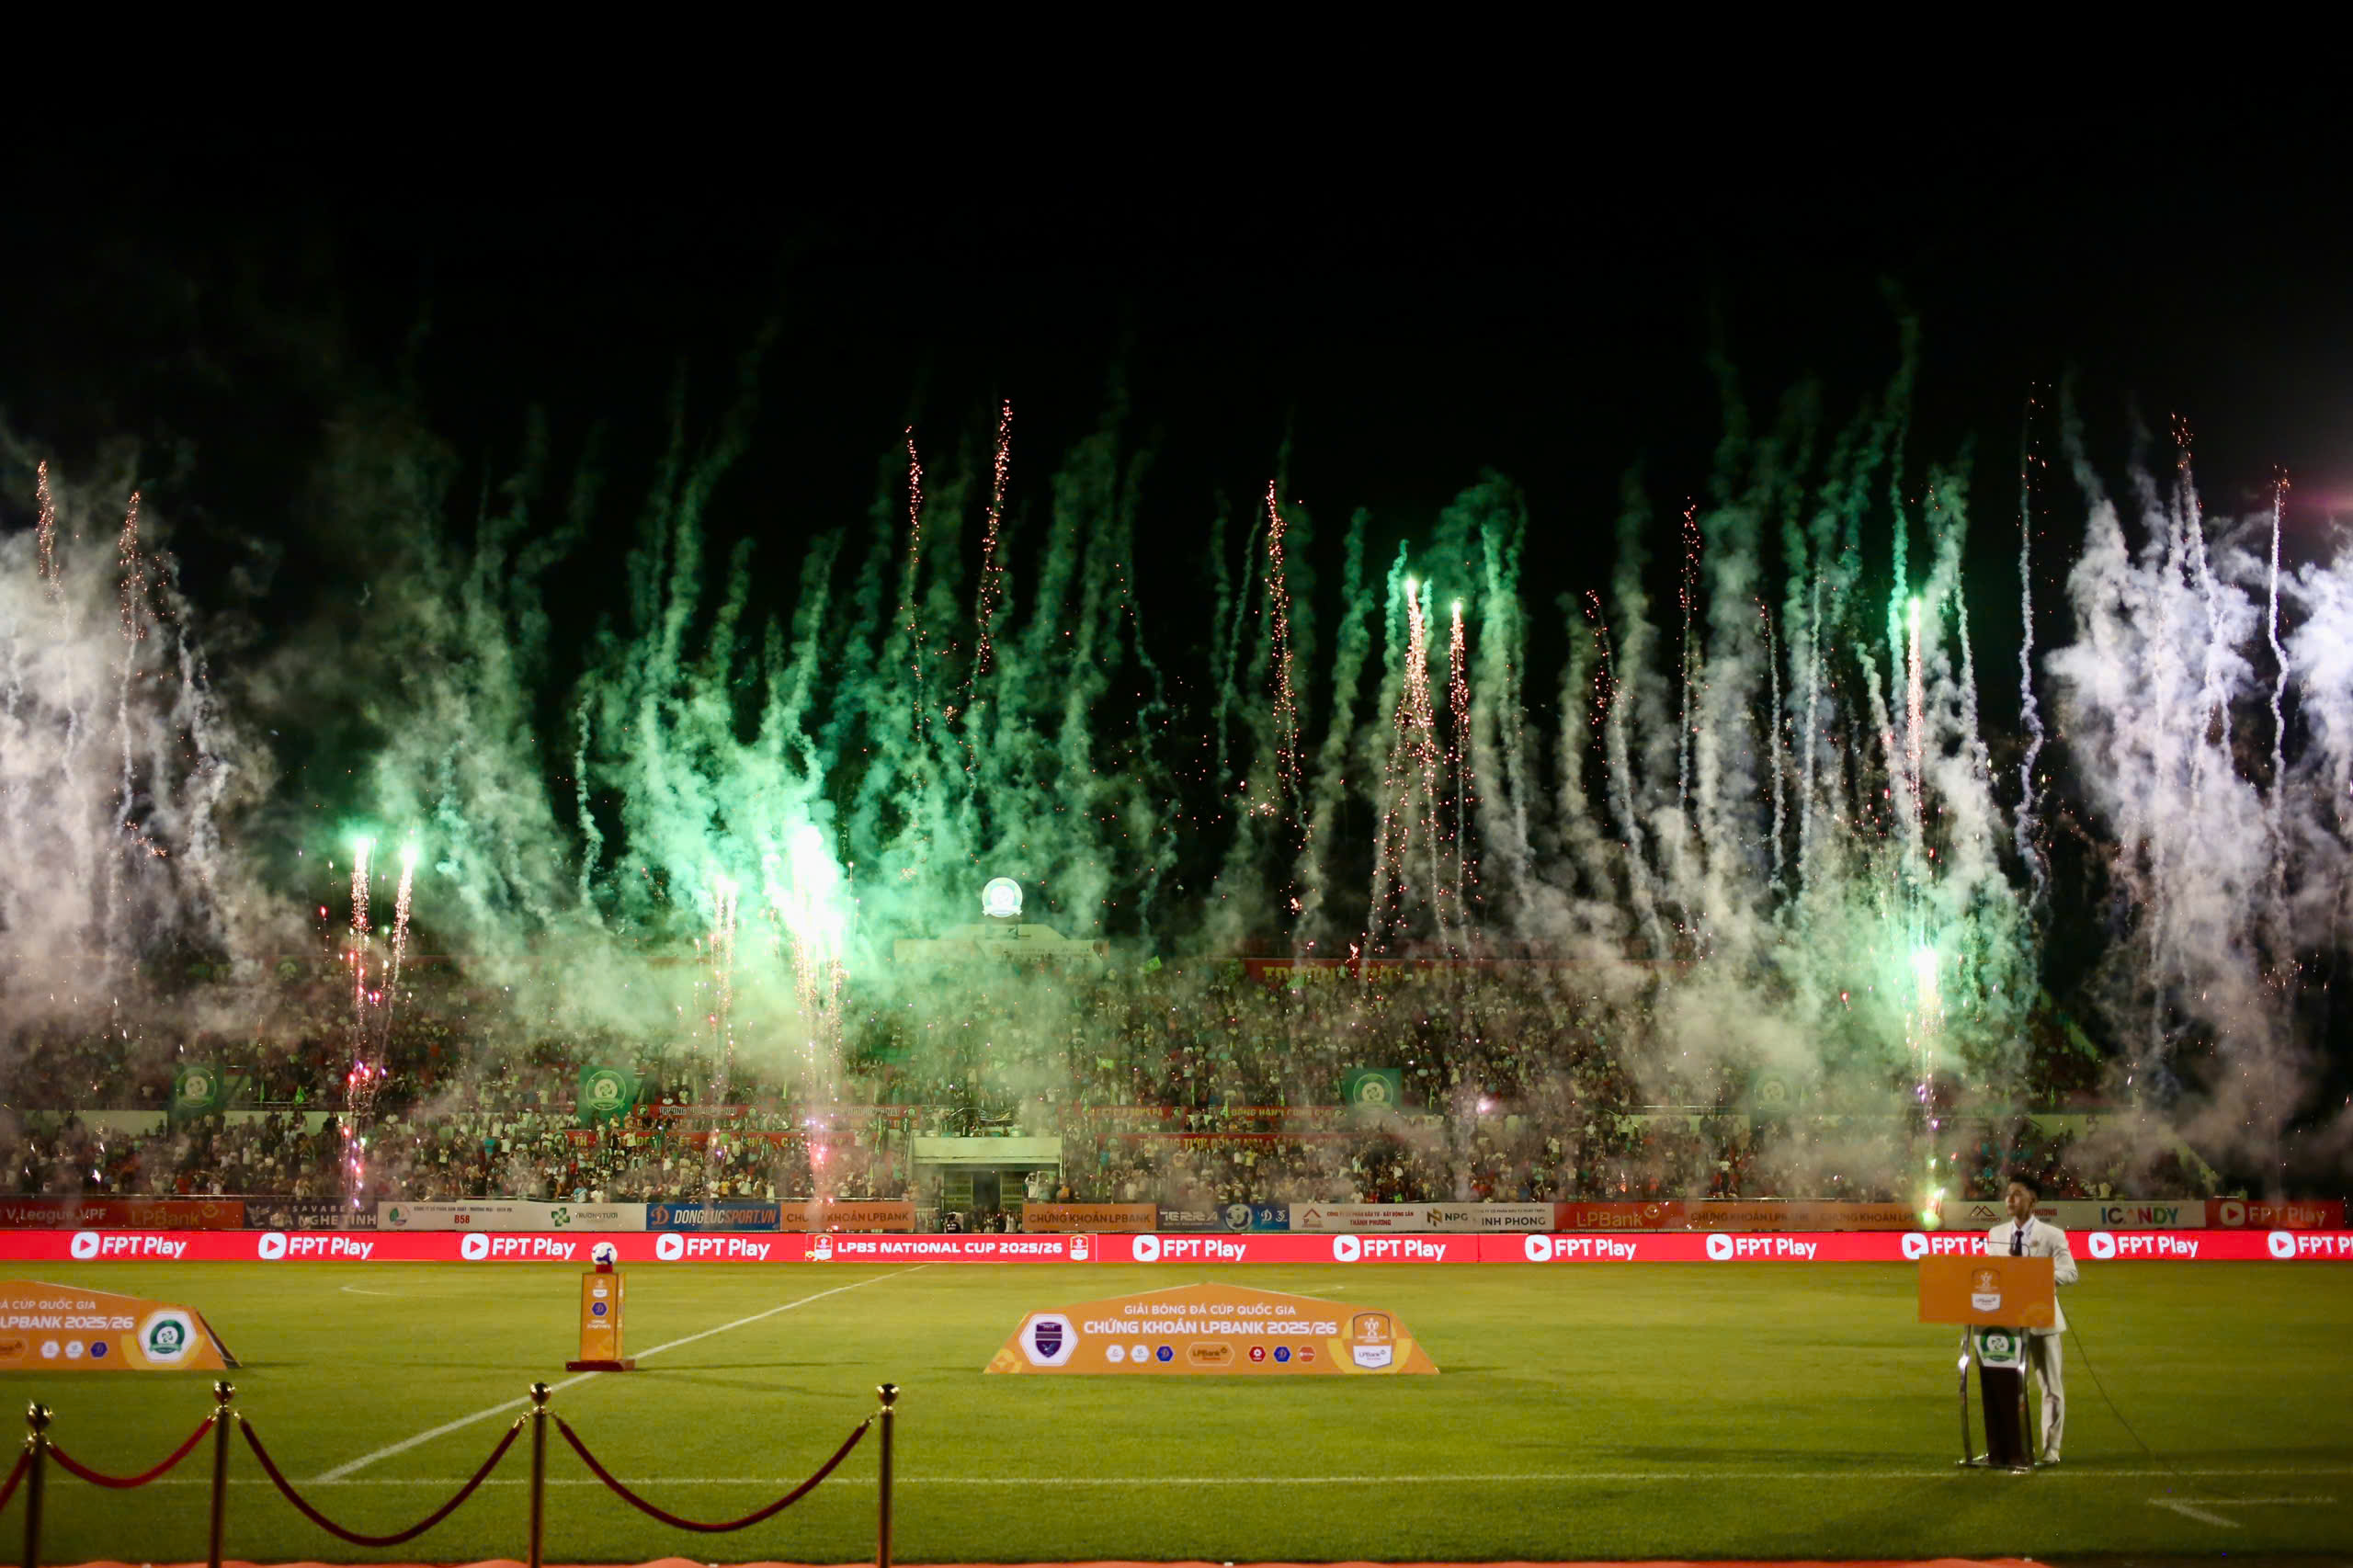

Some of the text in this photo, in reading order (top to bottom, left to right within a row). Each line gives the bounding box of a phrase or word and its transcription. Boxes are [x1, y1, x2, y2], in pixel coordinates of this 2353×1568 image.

[454, 1214, 470, 1224] B58
[867, 1211, 909, 1221] LPBANK
[1029, 1211, 1151, 1223] CHỨNG KHOÁN LPBANK
[1444, 1213, 1469, 1221] NPG
[1505, 1217, 1546, 1226] PHONG
[1576, 1212, 1643, 1227] LPBank
[2248, 1206, 2327, 1227] FPT Play
[102, 1236, 187, 1259] FPT Play
[290, 1237, 374, 1260] FPT Play
[492, 1238, 576, 1260] FPT Play
[687, 1238, 770, 1260] FPT Play
[837, 1242, 1063, 1255] LPBS NATIONAL CUP 2025/26
[1164, 1239, 1246, 1261] FPT Play
[1363, 1239, 1446, 1261] FPT Play
[1554, 1238, 1636, 1260] FPT Play
[1735, 1238, 1817, 1259] FPT Play
[1931, 1237, 1988, 1255] FPT Pl
[2118, 1236, 2199, 1257] FPT Play
[2298, 1236, 2335, 1254] FPT
[39, 1297, 73, 1311] QUỐC
[76, 1301, 97, 1310] GIA
[1151, 1303, 1186, 1314] BÓNG
[1189, 1303, 1208, 1314] ĐÁ
[1210, 1303, 1234, 1315] CÚP
[1236, 1302, 1272, 1315] QUỐC
[1275, 1305, 1296, 1315] GIA
[0, 1315, 134, 1329] LPBANK 2025/26
[1084, 1318, 1337, 1335] CHỨNG KHOÁN LPBANK 2025/26
